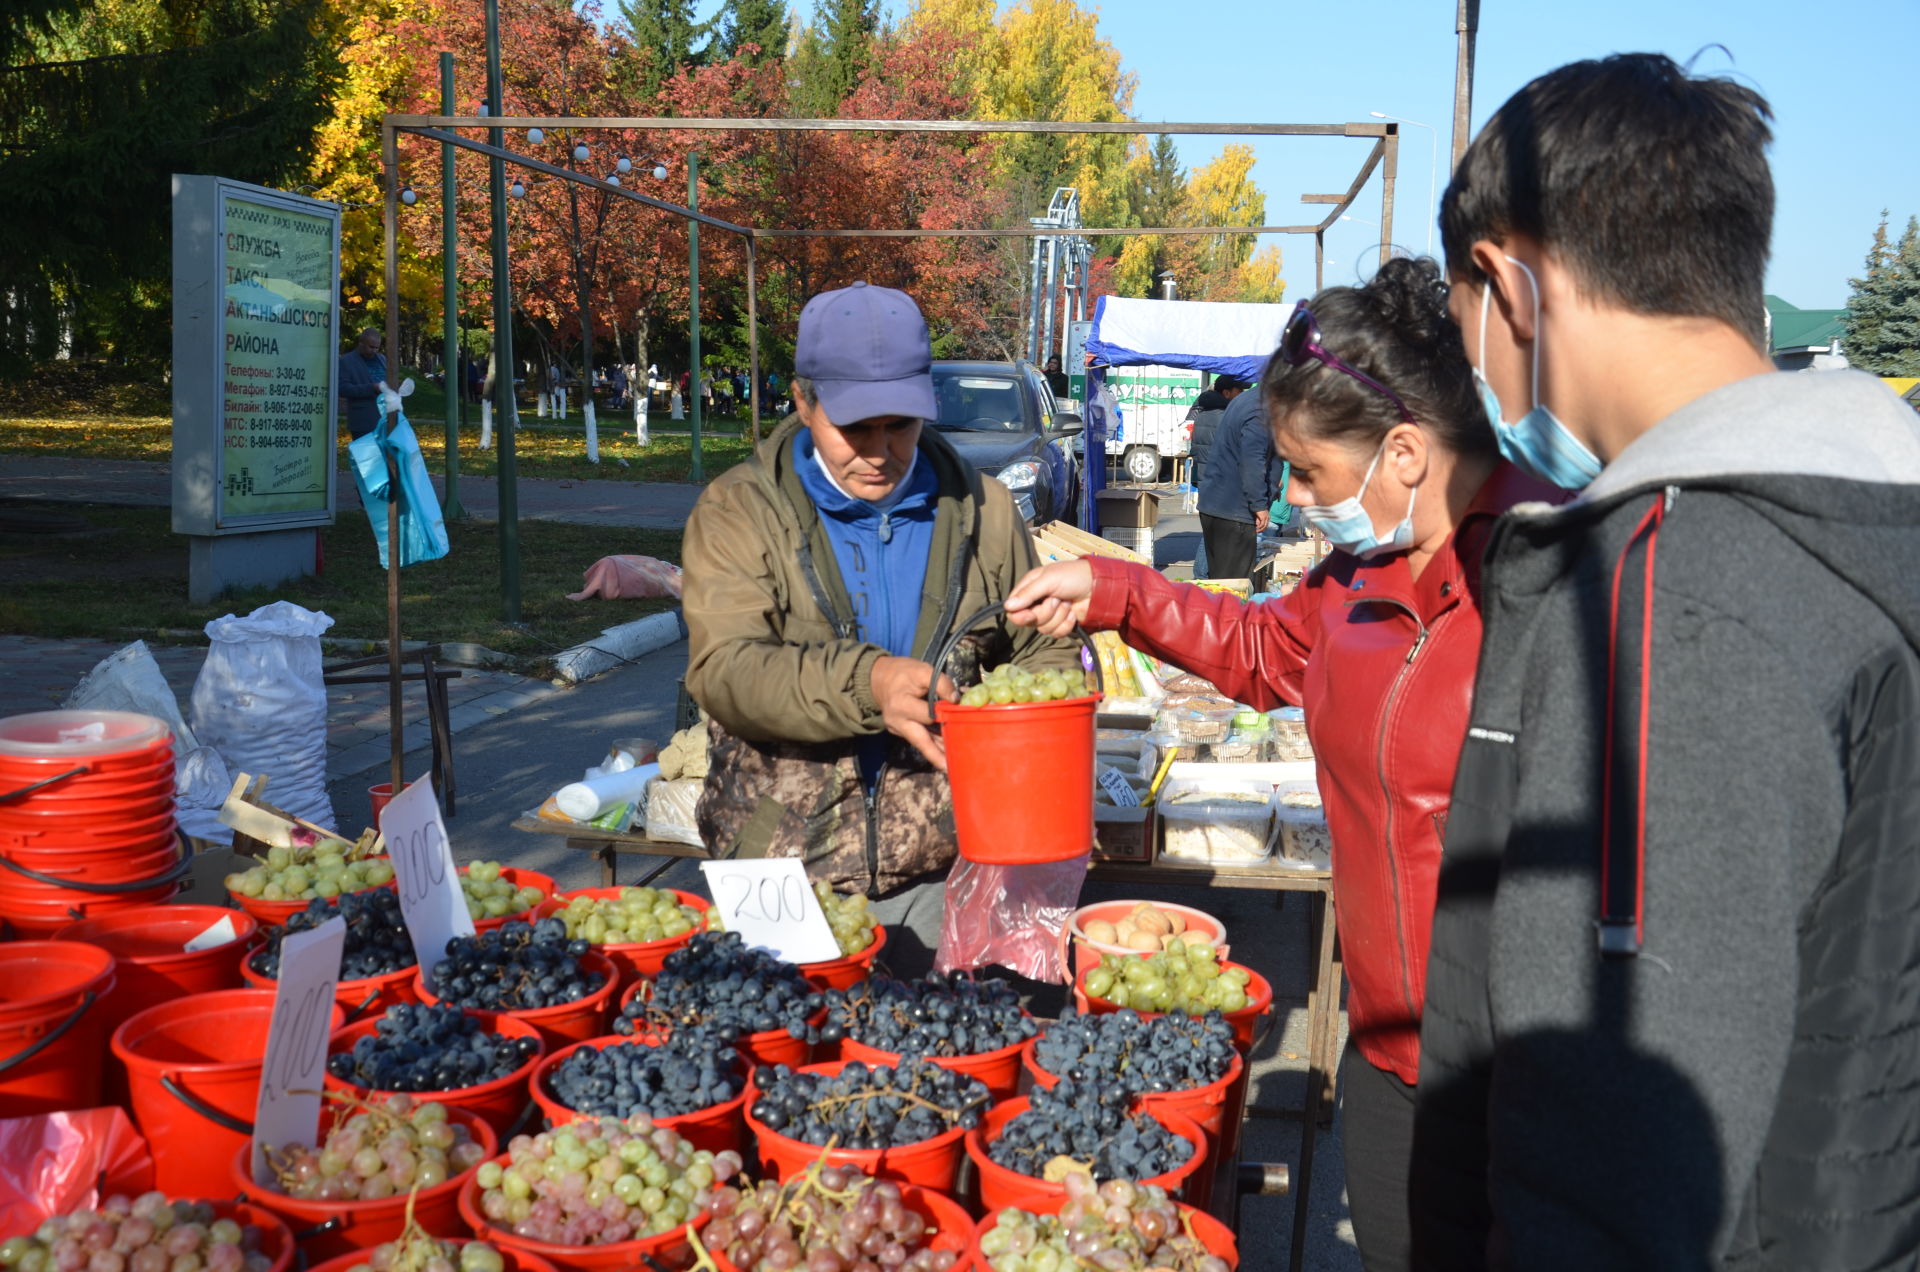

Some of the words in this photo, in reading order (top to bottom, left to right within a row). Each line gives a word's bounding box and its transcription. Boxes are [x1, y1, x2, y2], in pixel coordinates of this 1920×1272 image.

[226, 231, 281, 259] СЛУЖБА
[226, 265, 269, 289] ТАКСИ
[225, 299, 329, 329] АКТАНЫШСКОГО
[225, 331, 280, 356] РАЙОНА
[224, 362, 274, 380] Телефоны:
[276, 366, 306, 381] 3-30-02
[224, 381, 267, 398] Мегафон:
[224, 399, 262, 413] Билайн:
[224, 417, 248, 431] МТС:
[250, 418, 312, 432] 8-917-866-90-00
[224, 435, 248, 449] НСС:
[250, 435, 312, 449] 8-904-665-57-70
[392, 819, 446, 917] 200
[720, 871, 806, 923] 200
[259, 979, 332, 1110] 200
